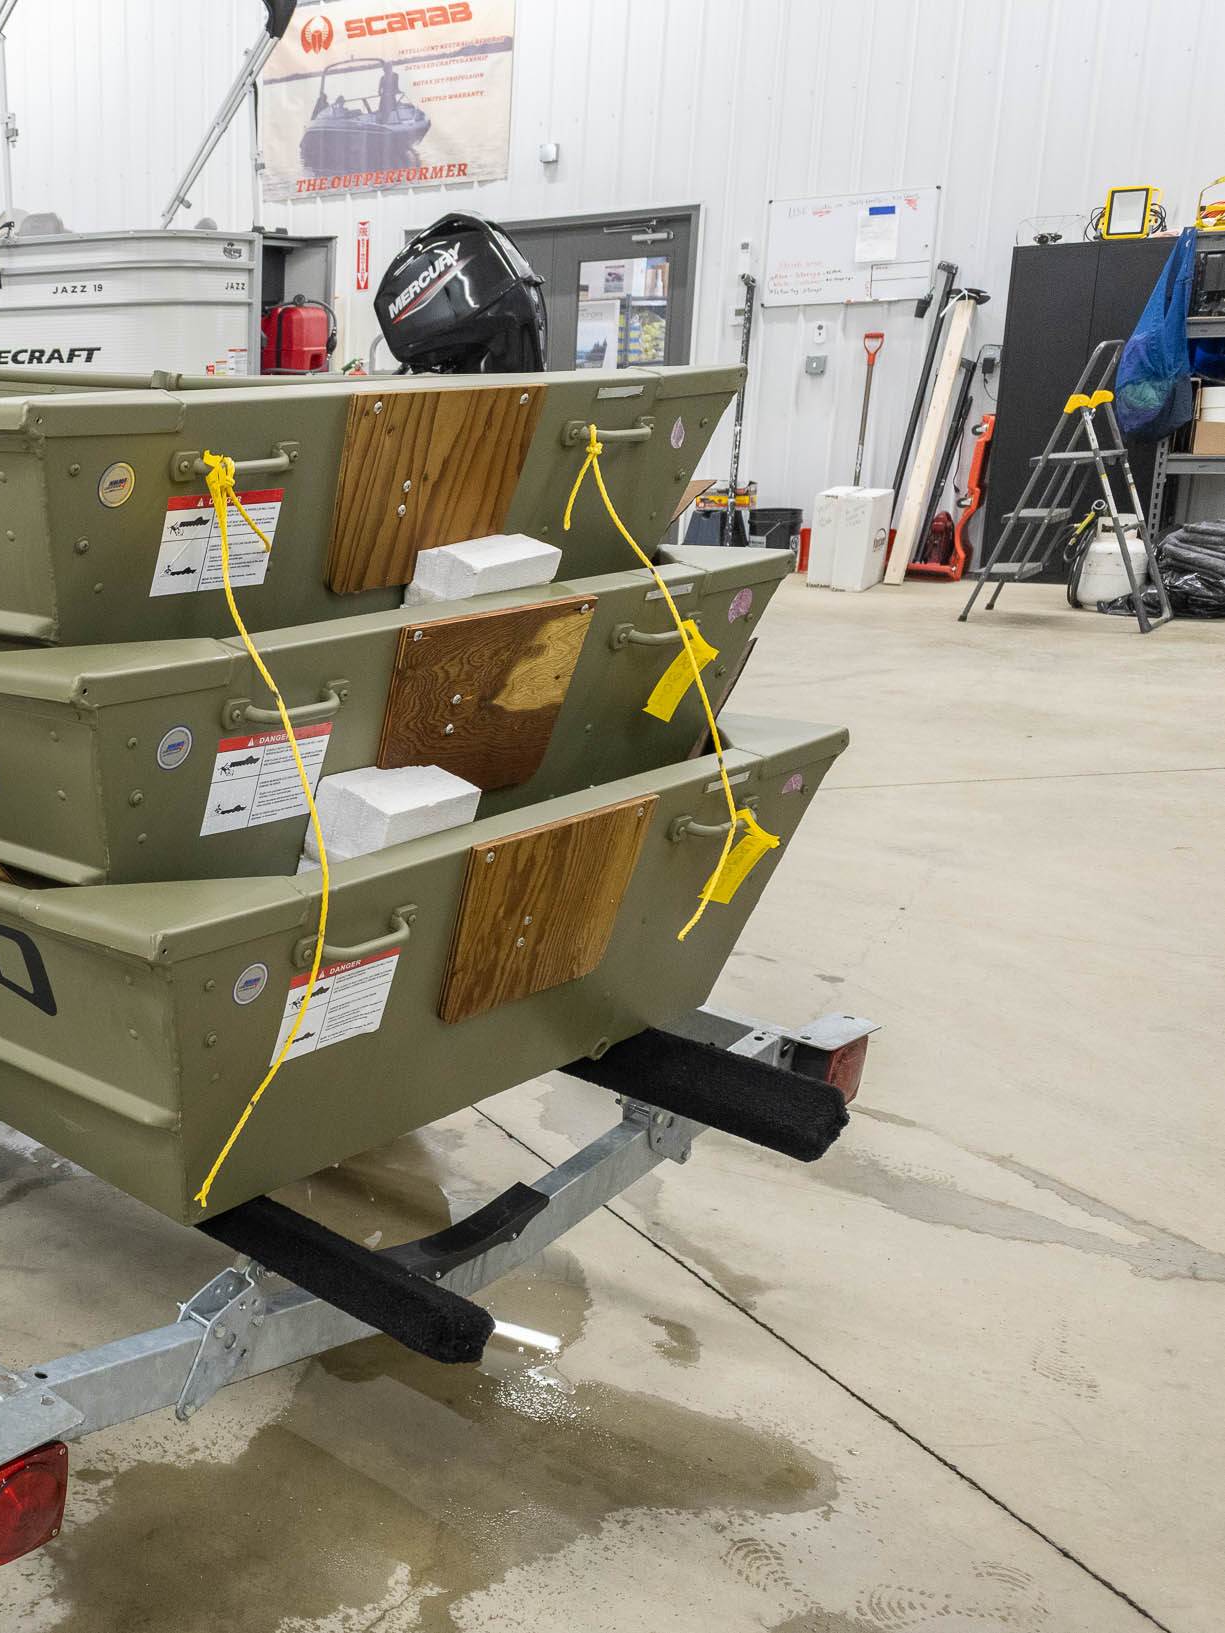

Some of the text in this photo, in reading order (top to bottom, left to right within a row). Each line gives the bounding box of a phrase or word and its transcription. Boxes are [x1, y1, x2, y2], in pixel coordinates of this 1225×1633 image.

[344, 2, 473, 39] SCARAB
[296, 163, 469, 193] THE OUTPERFORMER
[52, 283, 103, 294] JAZZ 19
[225, 282, 246, 291] JAZZ
[388, 242, 461, 320] MERCURY
[259, 732, 291, 745] DANGE
[329, 959, 362, 975] DANGER
